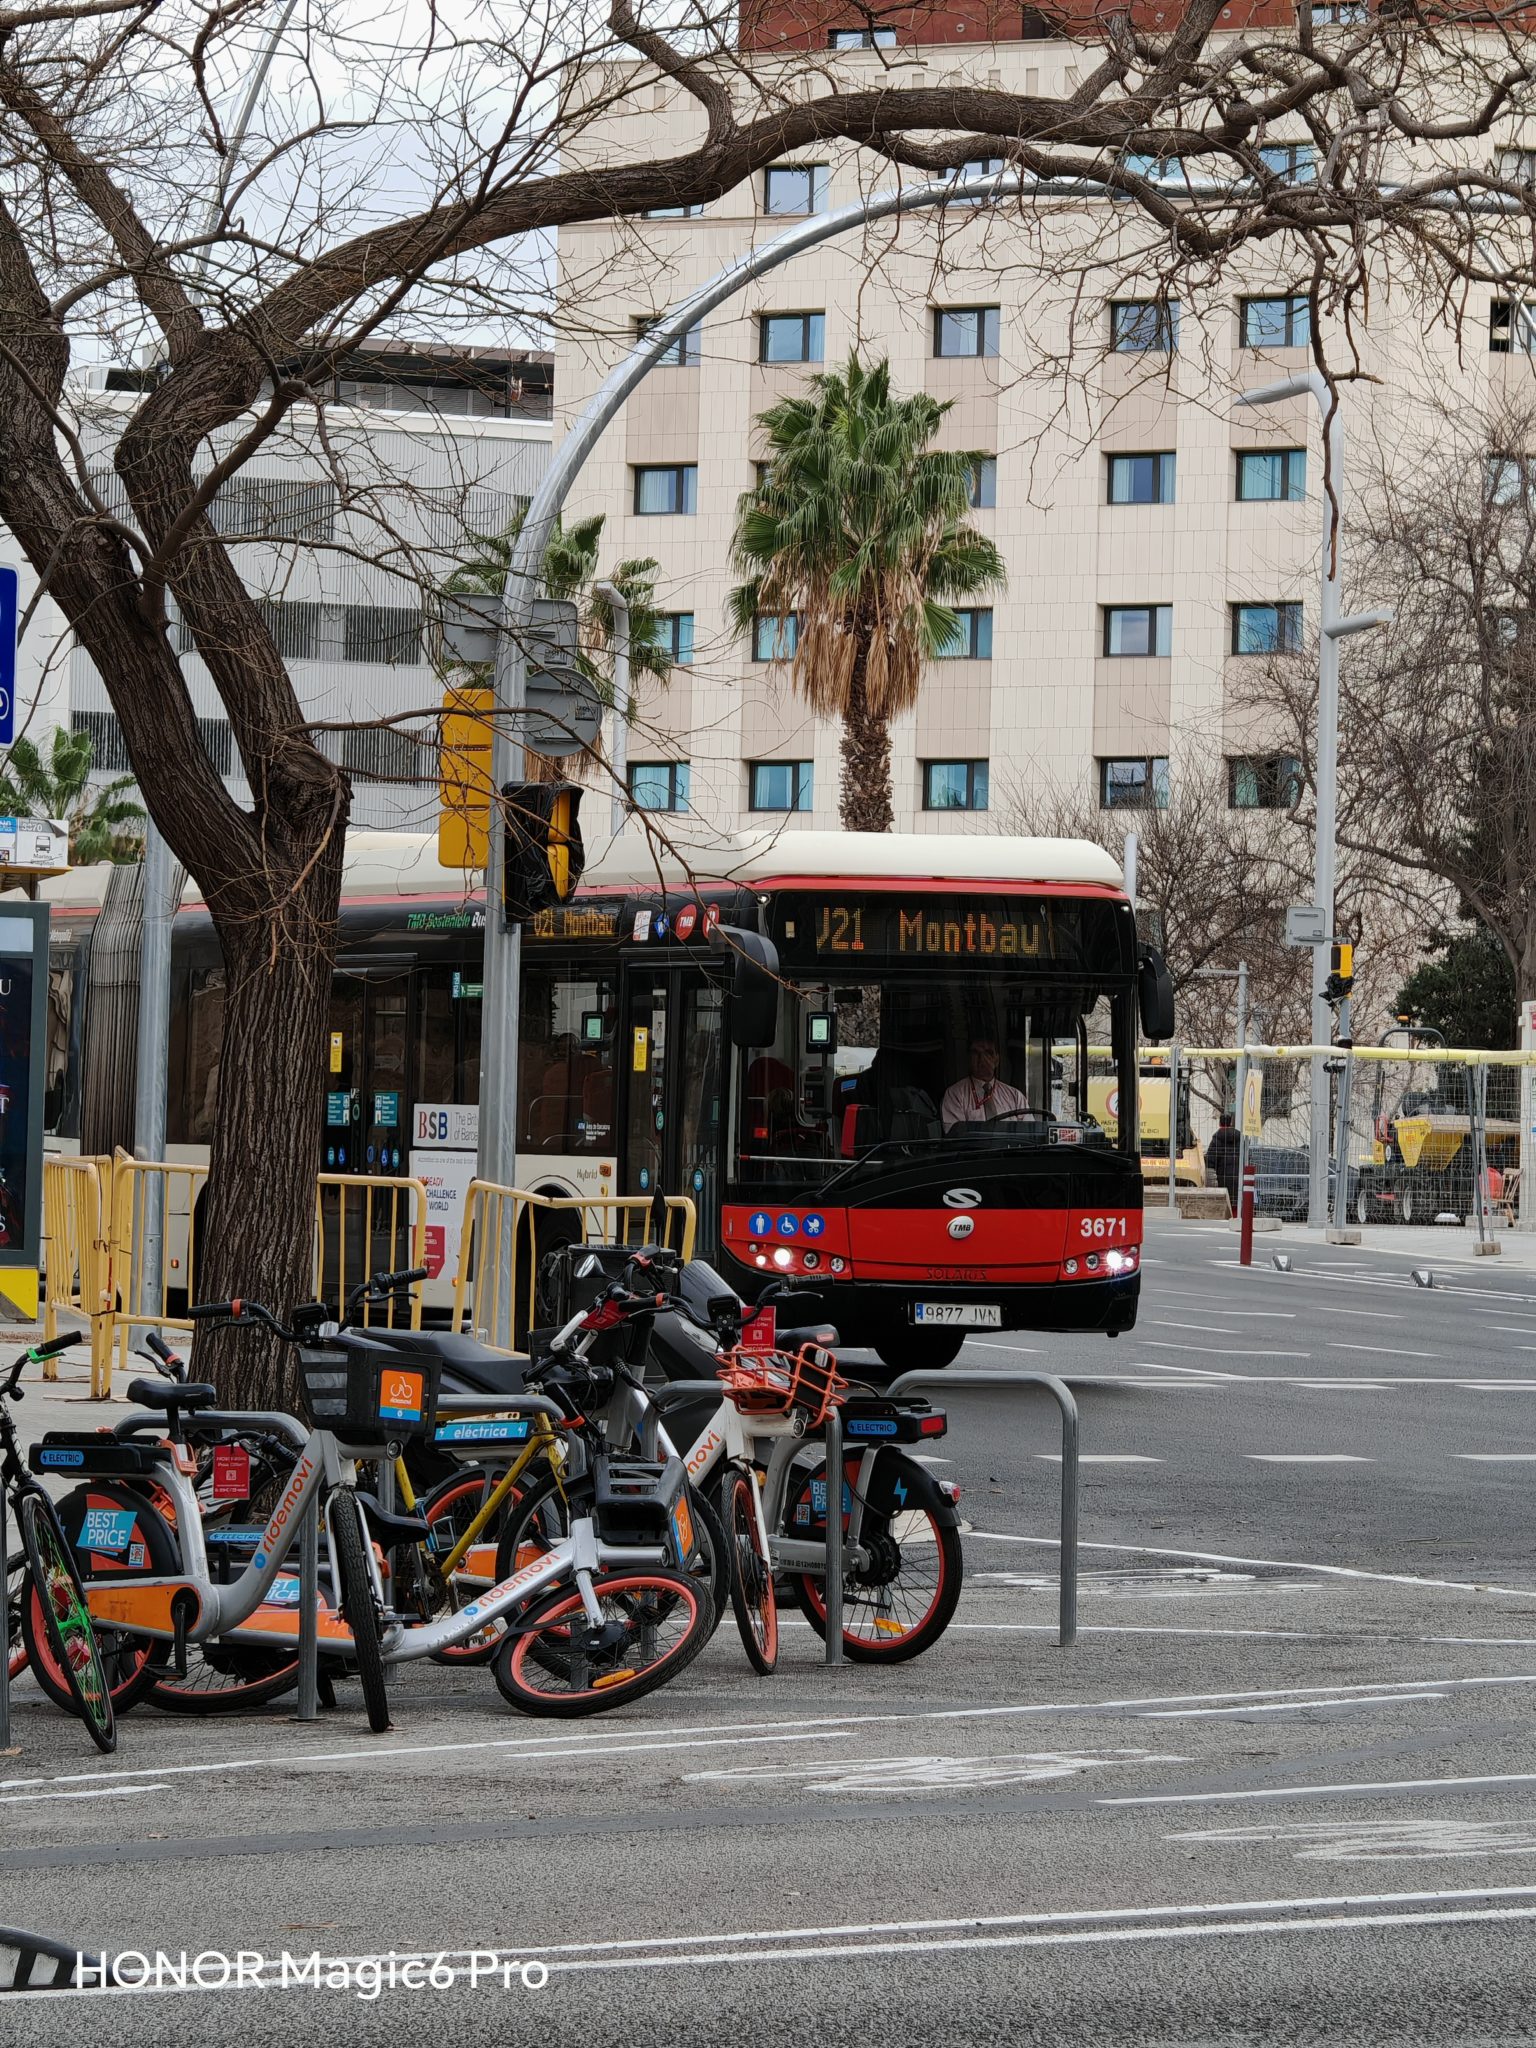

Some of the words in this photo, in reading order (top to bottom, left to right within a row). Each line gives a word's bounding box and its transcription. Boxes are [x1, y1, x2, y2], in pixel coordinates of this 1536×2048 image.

[680, 916, 694, 928] TMB
[816, 907, 864, 951] J21
[900, 909, 1039, 953] Montbau
[417, 1111, 448, 1139] BSB
[454, 1112, 465, 1126] The
[453, 1129, 460, 1141] of
[576, 1168, 598, 1182] Hybrid
[429, 1201, 449, 1211] WORLD
[953, 1224, 971, 1232] TMB
[1080, 1217, 1127, 1237] 3671
[926, 1267, 987, 1281] SOLARIS
[925, 1306, 964, 1323] 9877
[970, 1307, 997, 1324] JVN
[454, 1424, 508, 1438] eléctrica
[857, 1423, 893, 1432] ELECTRIC
[48, 1453, 80, 1463] ELECTRIC
[262, 1455, 314, 1554] ridemovi
[87, 1512, 119, 1528] BEST
[88, 1530, 126, 1546] PRICE
[478, 1552, 561, 1607] ridemovi
